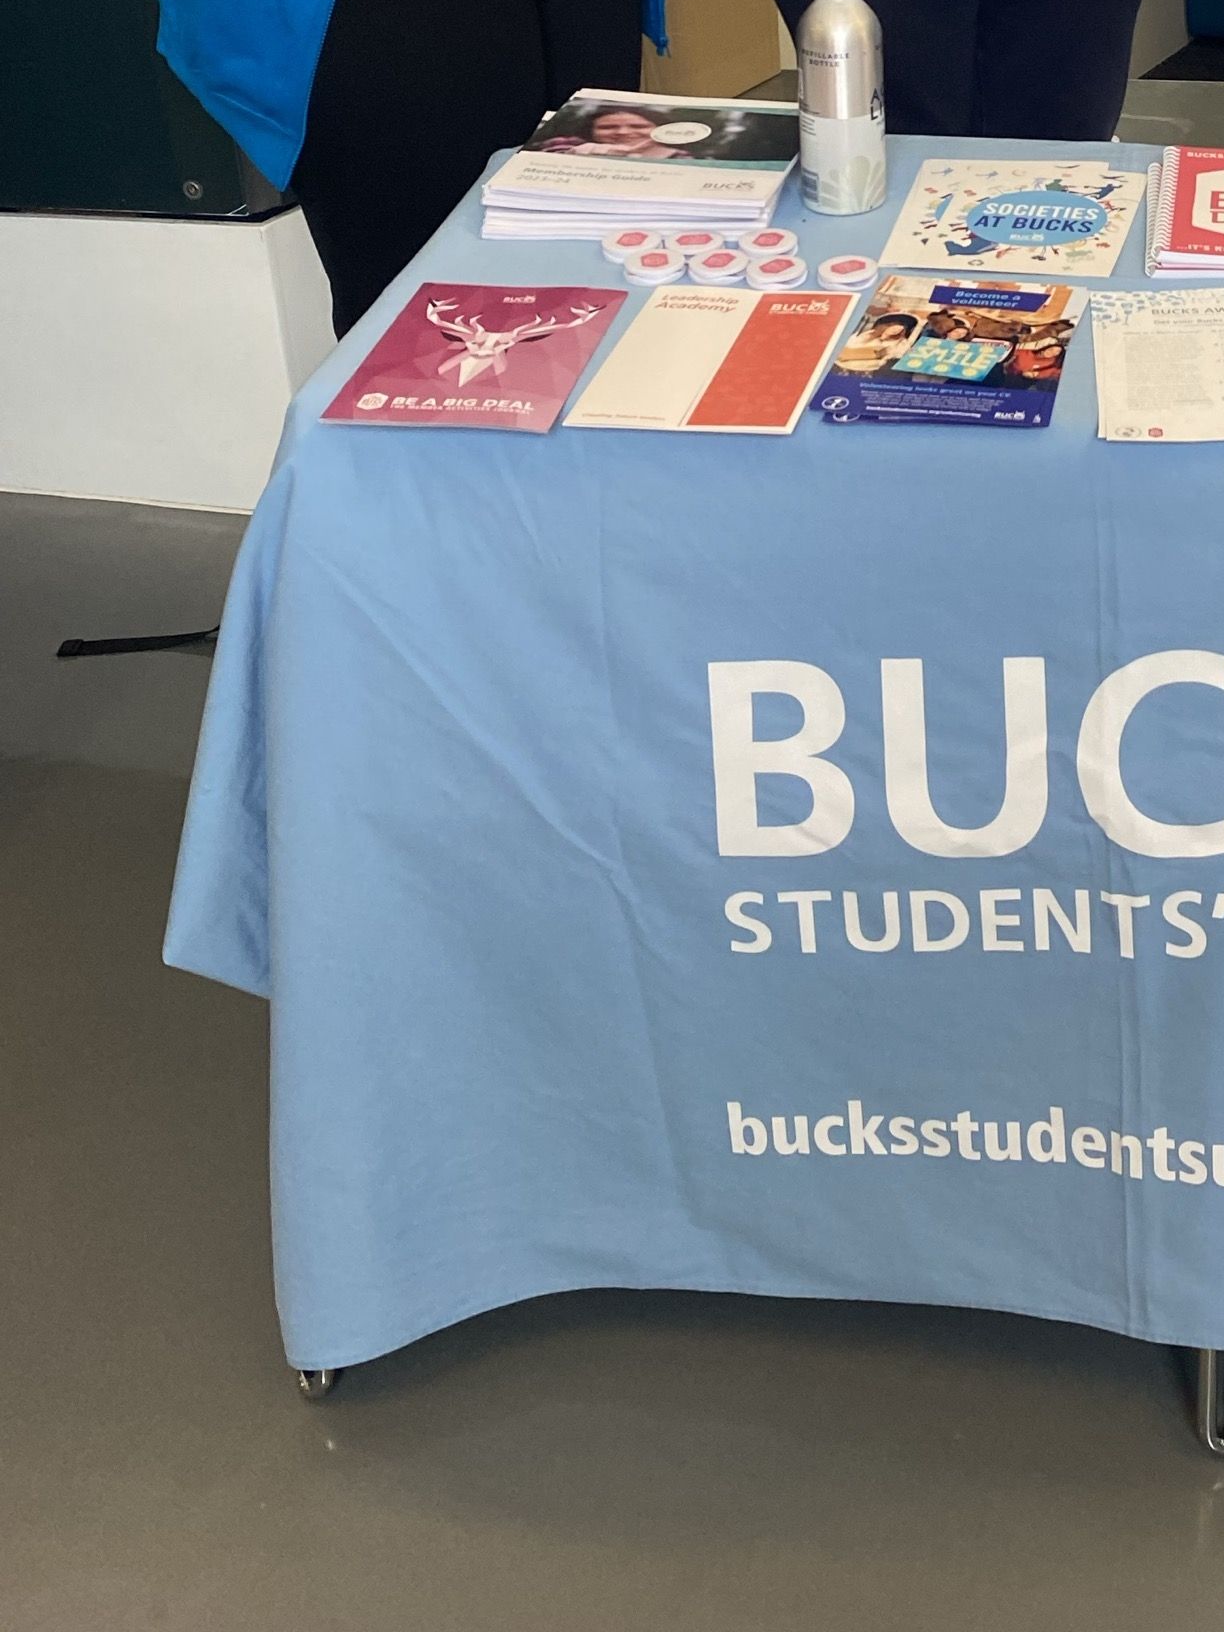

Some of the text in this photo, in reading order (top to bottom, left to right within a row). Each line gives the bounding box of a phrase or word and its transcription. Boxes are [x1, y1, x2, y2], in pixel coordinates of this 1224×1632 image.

[801, 49, 849, 60] REFILLABLE
[808, 58, 840, 67] BOTTLE
[1186, 151, 1224, 159] BUCKS
[523, 167, 608, 180] Membership
[611, 174, 651, 182] Guide
[702, 180, 755, 190] BUCKS
[983, 202, 1099, 220] SOCIETIES
[974, 215, 1094, 233] AT BUCKS
[661, 294, 740, 305] Leadership
[955, 290, 1009, 300] Become
[655, 301, 737, 313] Academy
[768, 301, 831, 312] BUCKS
[951, 298, 1019, 308] volunteer
[908, 344, 999, 369] SMILE
[391, 396, 419, 407] BE
[421, 397, 437, 407] A
[442, 398, 478, 408] BIG
[482, 399, 535, 411] DEAL
